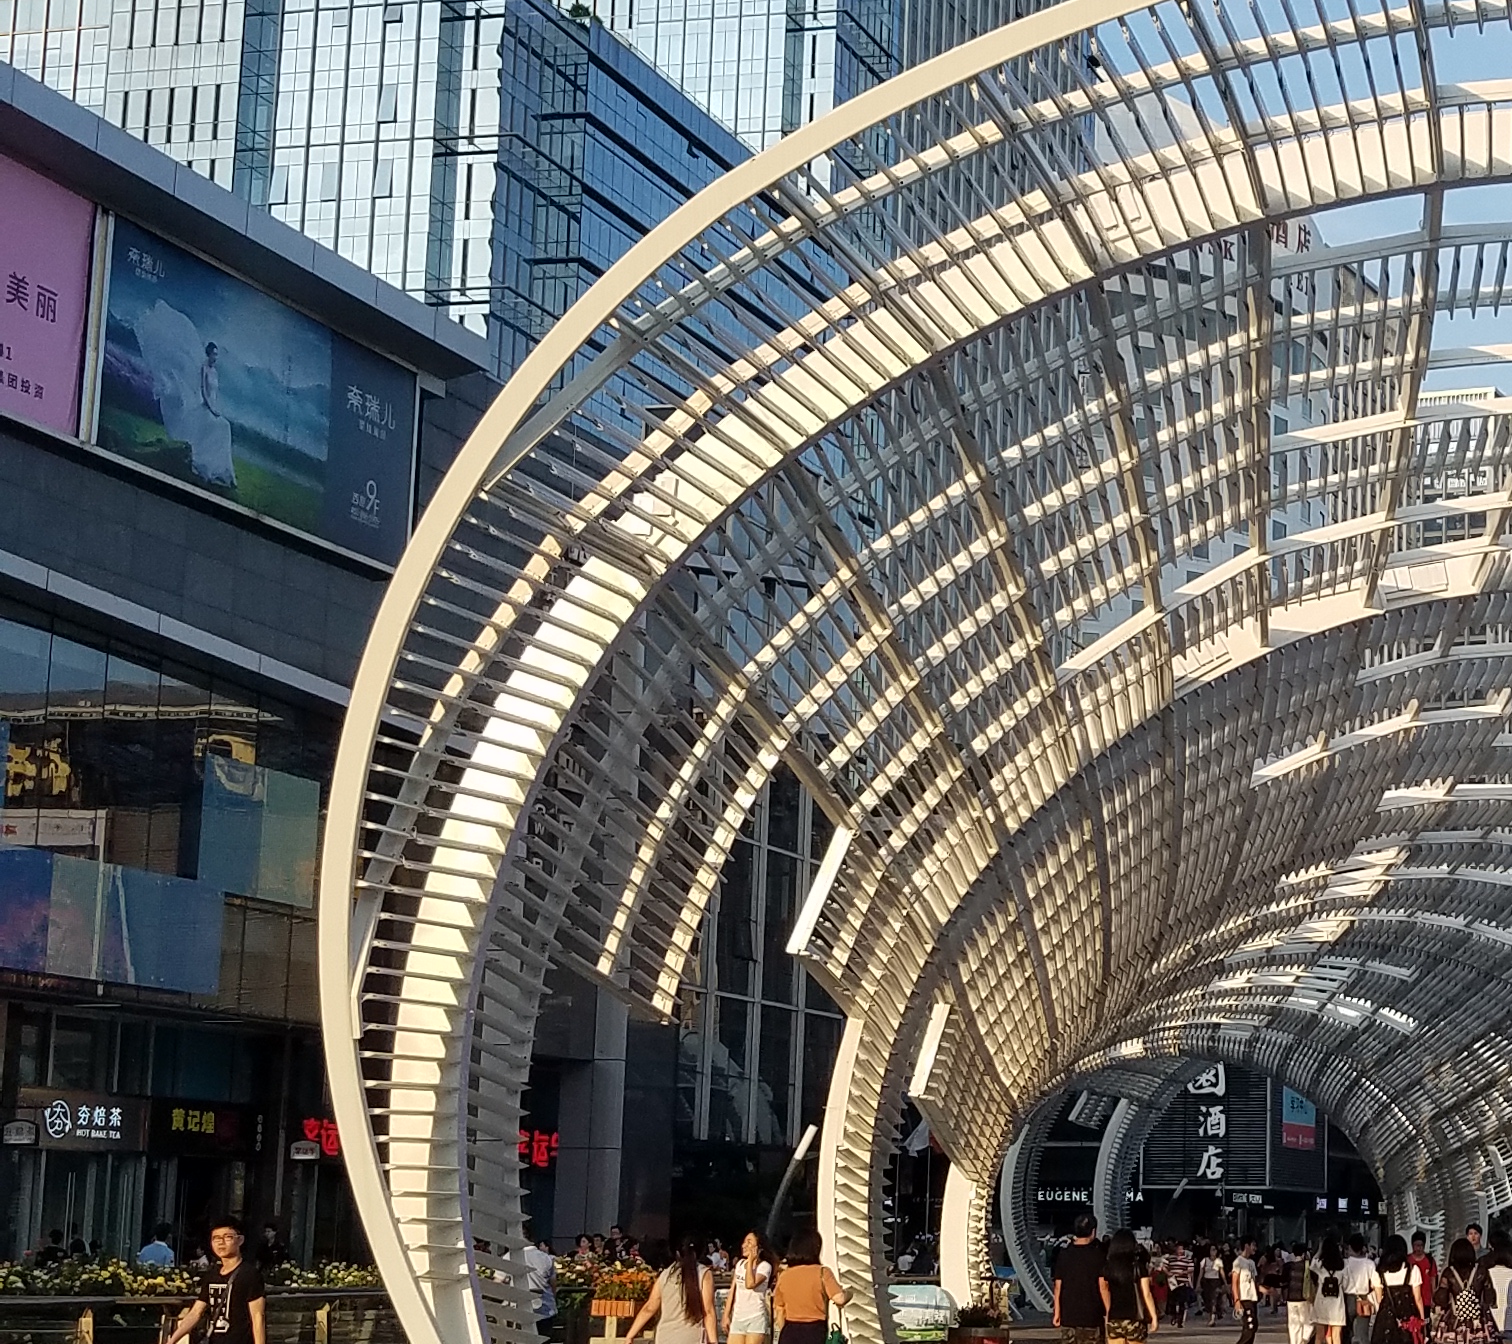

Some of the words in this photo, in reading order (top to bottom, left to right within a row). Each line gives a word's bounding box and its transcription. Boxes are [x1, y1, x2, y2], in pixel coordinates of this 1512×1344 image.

[5, 271, 58, 323] 美丽
[77, 1105, 122, 1127] 夯焙茶
[171, 1108, 215, 1133] 黄记煌
[76, 1129, 90, 1137] HOT
[109, 1131, 121, 1139] TEA
[1037, 1190, 1089, 1202] EUGENE
